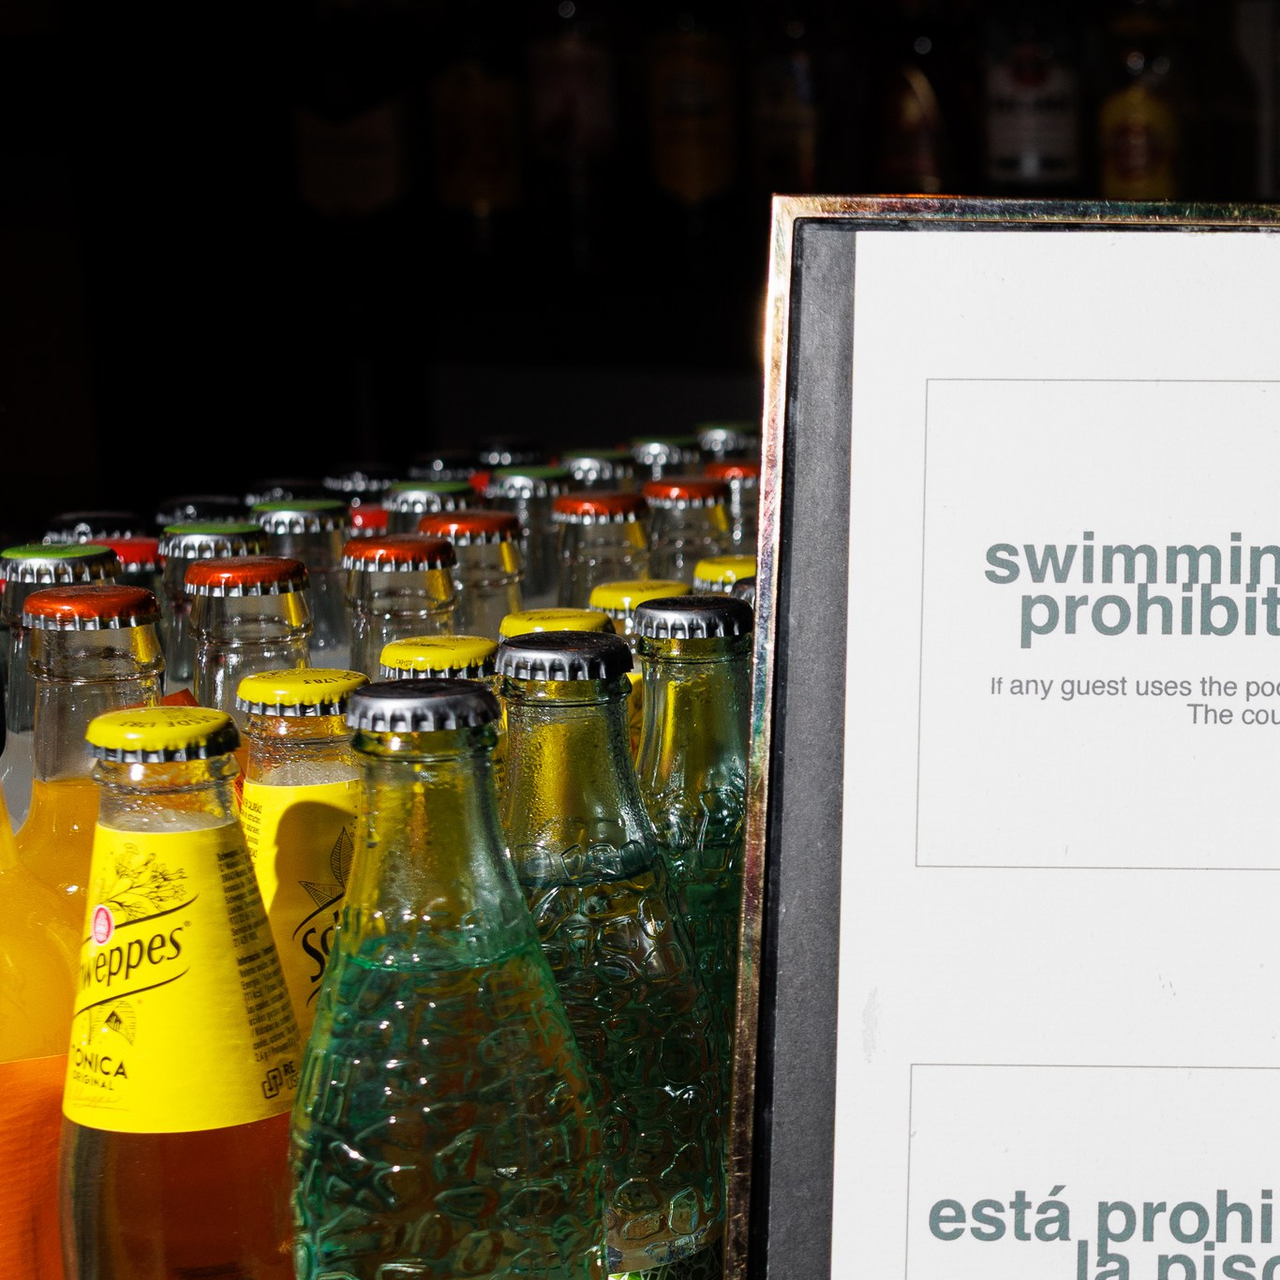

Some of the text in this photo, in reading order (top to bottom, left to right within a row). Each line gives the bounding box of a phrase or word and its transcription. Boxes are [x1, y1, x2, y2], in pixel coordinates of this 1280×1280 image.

[991, 677, 1003, 694] If
[1010, 679, 1053, 700] any
[1061, 677, 1127, 701] guest
[1136, 680, 1192, 696] uses
[1200, 676, 1237, 697] the
[1187, 704, 1233, 725] The
[81, 927, 183, 990] weppes
[929, 1185, 1071, 1241] está
